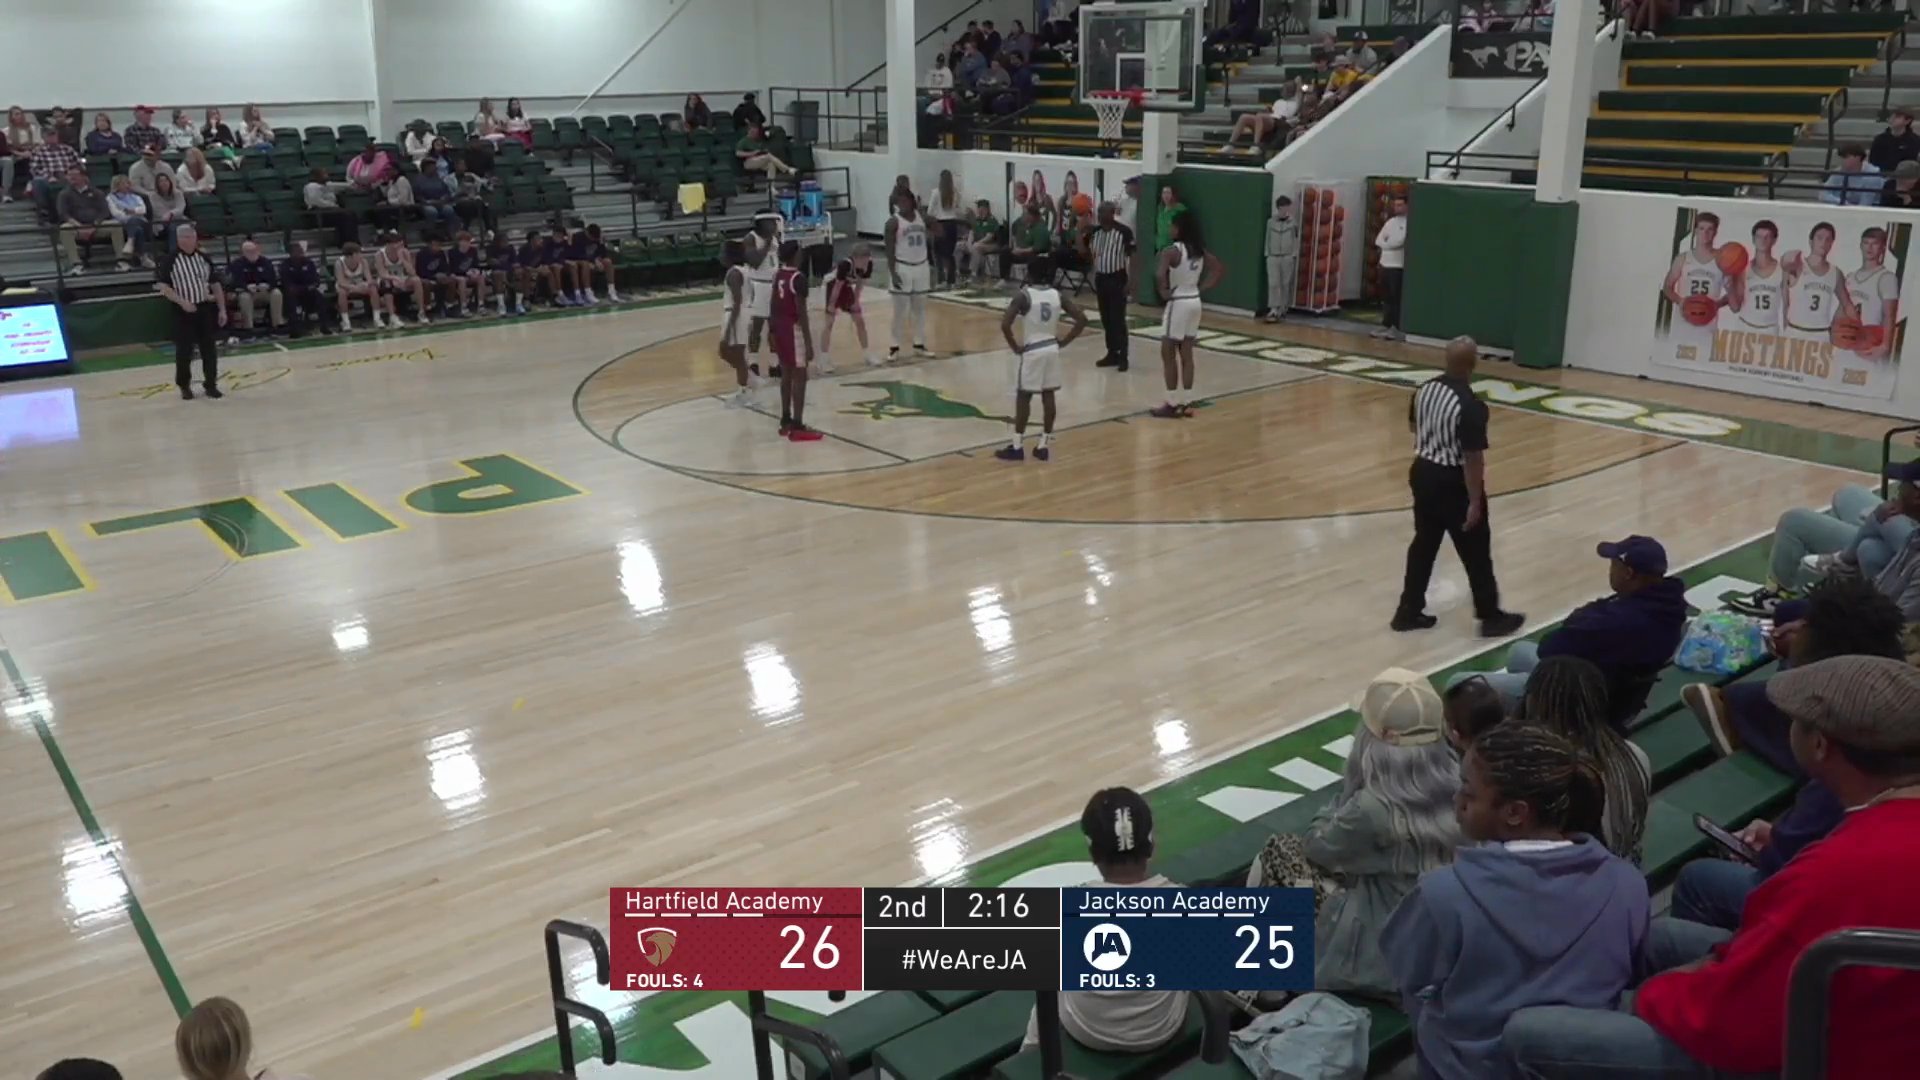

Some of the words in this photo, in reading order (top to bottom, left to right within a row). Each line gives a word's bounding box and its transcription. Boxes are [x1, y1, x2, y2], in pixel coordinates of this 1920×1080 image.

[1754, 294, 1771, 311] 15
[1809, 294, 1821, 312] 3
[1709, 328, 1833, 378] MUSTANGS
